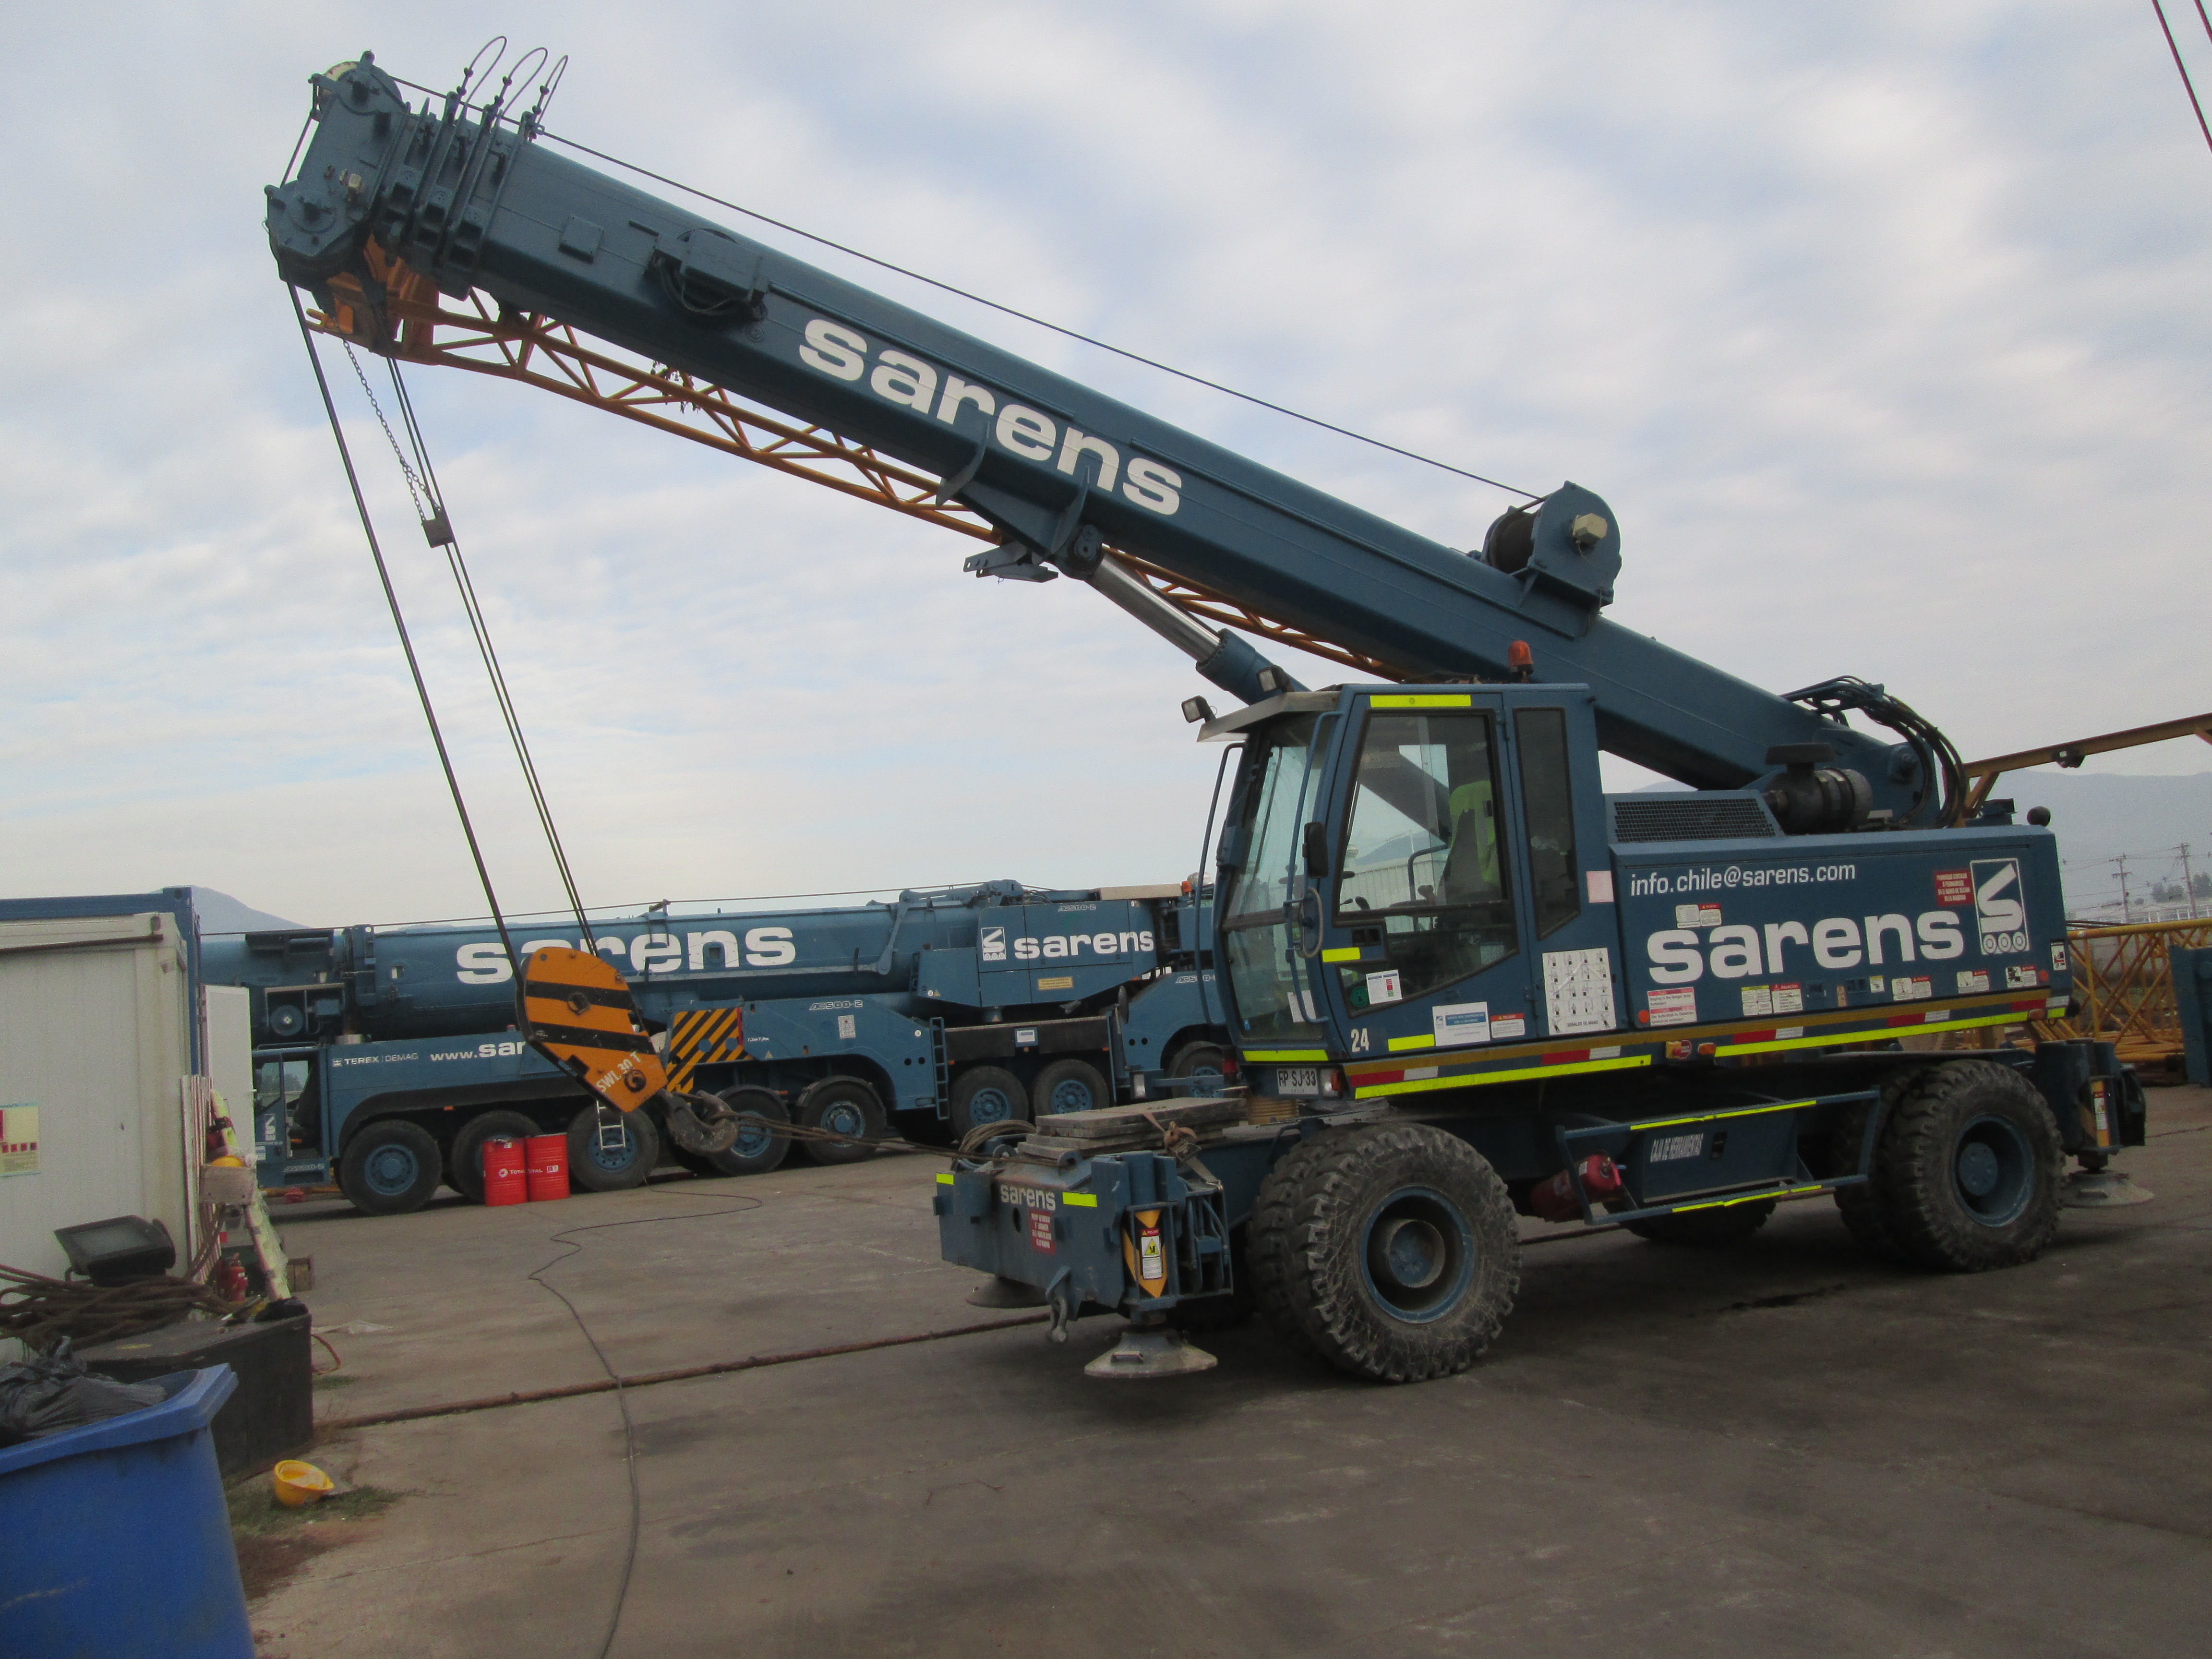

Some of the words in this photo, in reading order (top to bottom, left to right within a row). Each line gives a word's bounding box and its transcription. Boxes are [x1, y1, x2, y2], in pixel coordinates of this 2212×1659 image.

[799, 319, 1182, 516] sarens
[1631, 865, 1855, 896] info.chile@sarens.com
[457, 926, 796, 985] srens
[1014, 930, 1154, 960] sarens
[1647, 910, 1964, 984] sarens
[1351, 1028, 1370, 1053] 24
[344, 1056, 380, 1065] TEREX
[385, 1053, 419, 1062] DEMAG
[595, 1070, 622, 1093] SWL
[630, 1051, 642, 1062] T
[1000, 1184, 1056, 1211] sarens
